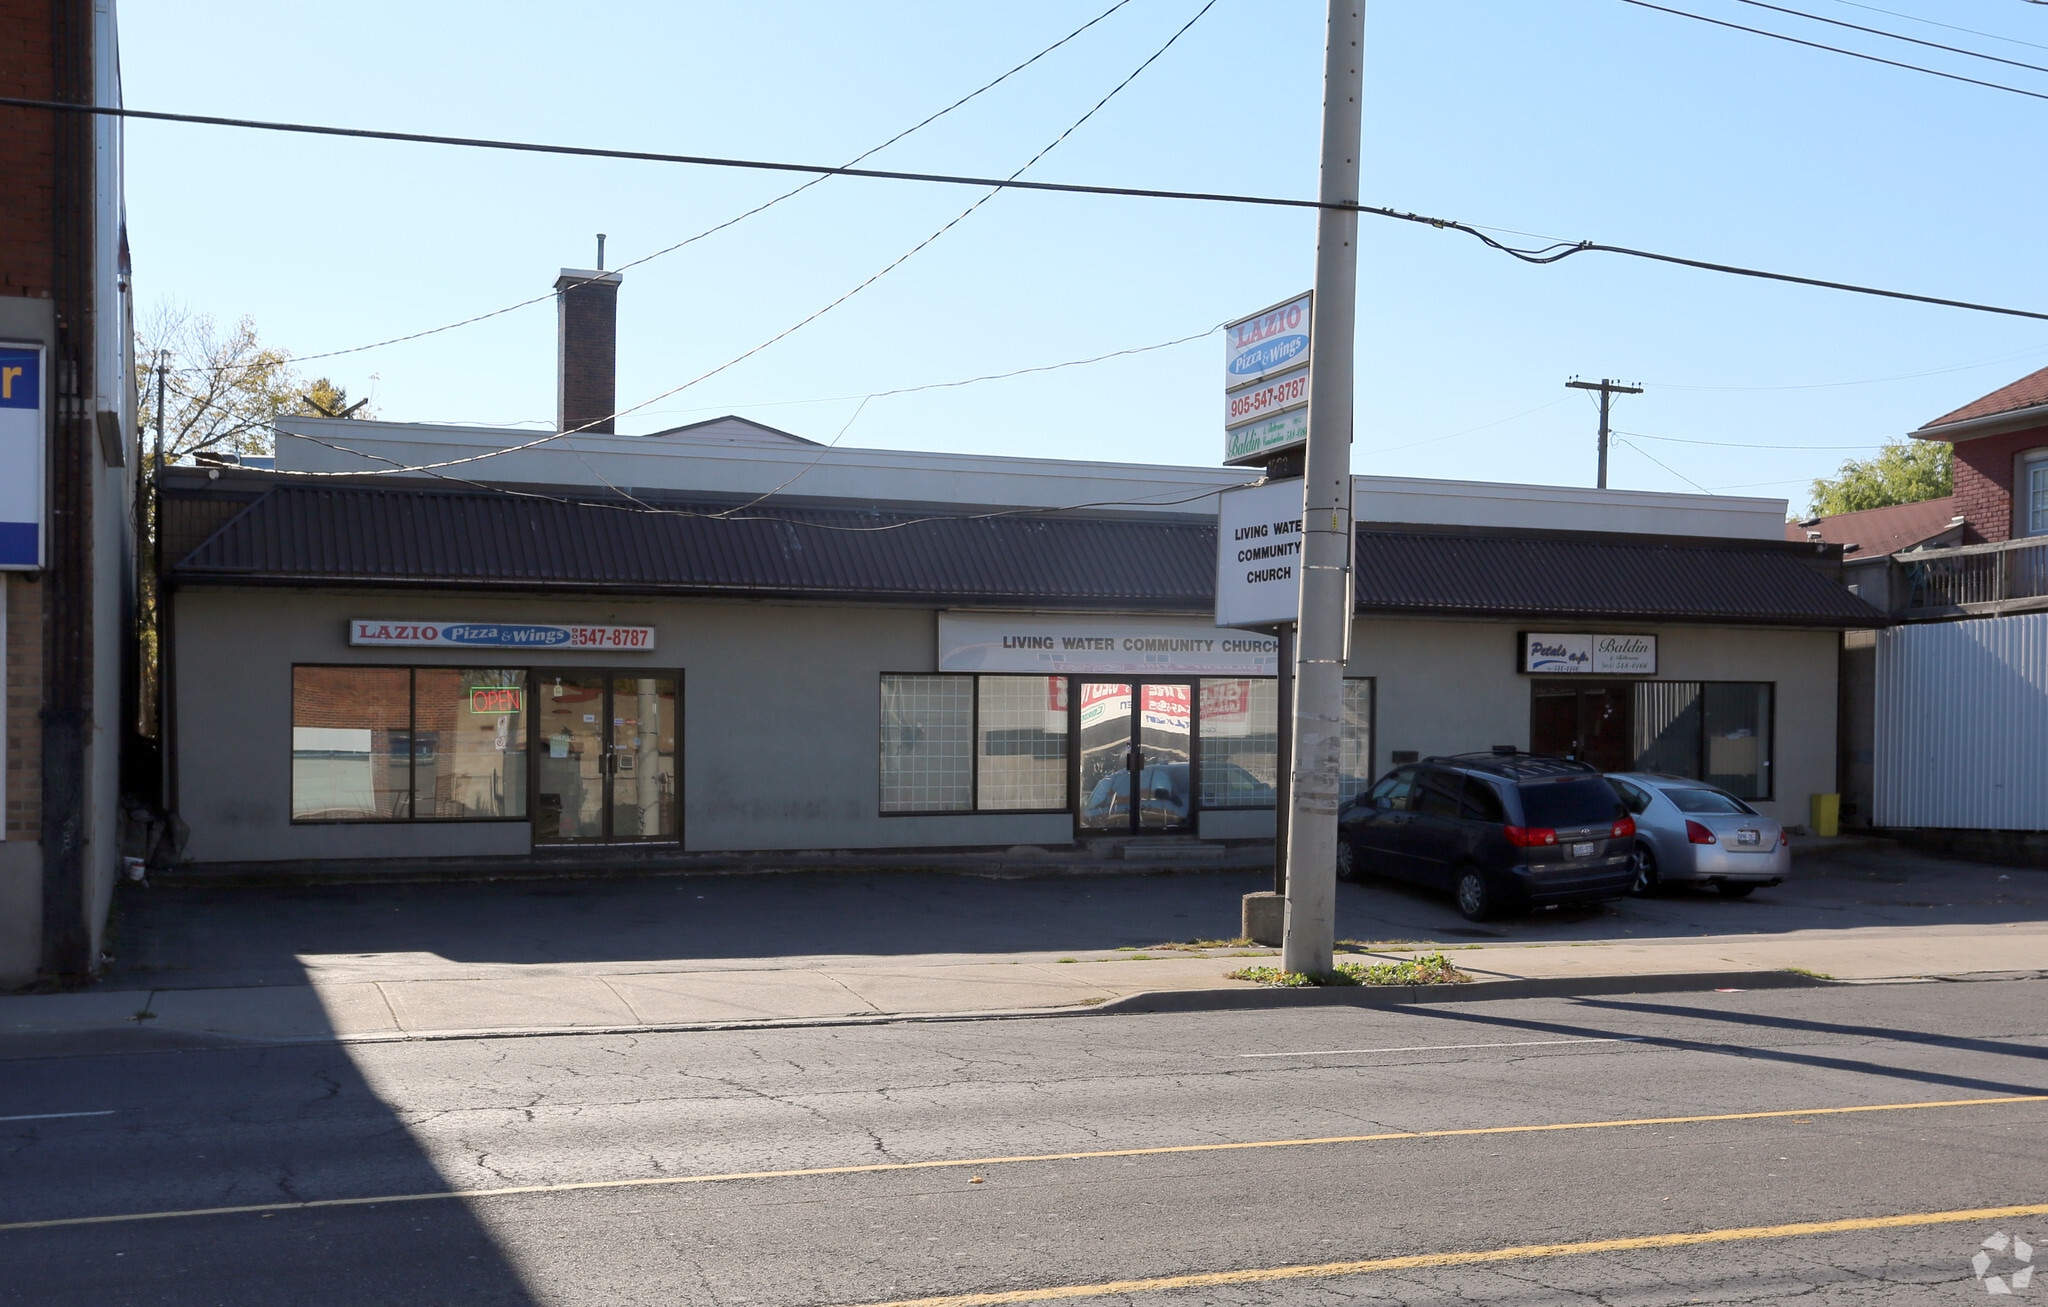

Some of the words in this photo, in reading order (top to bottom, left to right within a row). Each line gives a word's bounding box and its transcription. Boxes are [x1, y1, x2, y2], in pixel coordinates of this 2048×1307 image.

[1236, 304, 1301, 349] LAZIO
[1235, 350, 1262, 373] Pizza
[1262, 351, 1270, 366] &
[1270, 337, 1301, 363] Wings
[1231, 377, 1306, 417] 905-547-8787
[1228, 429, 1261, 458] Baldin
[1235, 524, 1268, 541] LIVING
[1273, 519, 1302, 535] WATE
[1238, 541, 1302, 562] COMMUNITY
[1247, 566, 1291, 584] CHURCH
[358, 624, 439, 641] LAZIO
[451, 626, 498, 640] Pizza
[501, 631, 512, 642] &
[514, 629, 564, 643] Wings
[579, 628, 648, 646] 547-8787
[1003, 636, 1054, 649] LIVING
[1061, 637, 1115, 651] WATER
[1123, 638, 1214, 652] COMMUNITY
[1598, 638, 1648, 653] Baldin
[1531, 641, 1567, 657] Petals
[473, 690, 520, 712] OPEN
